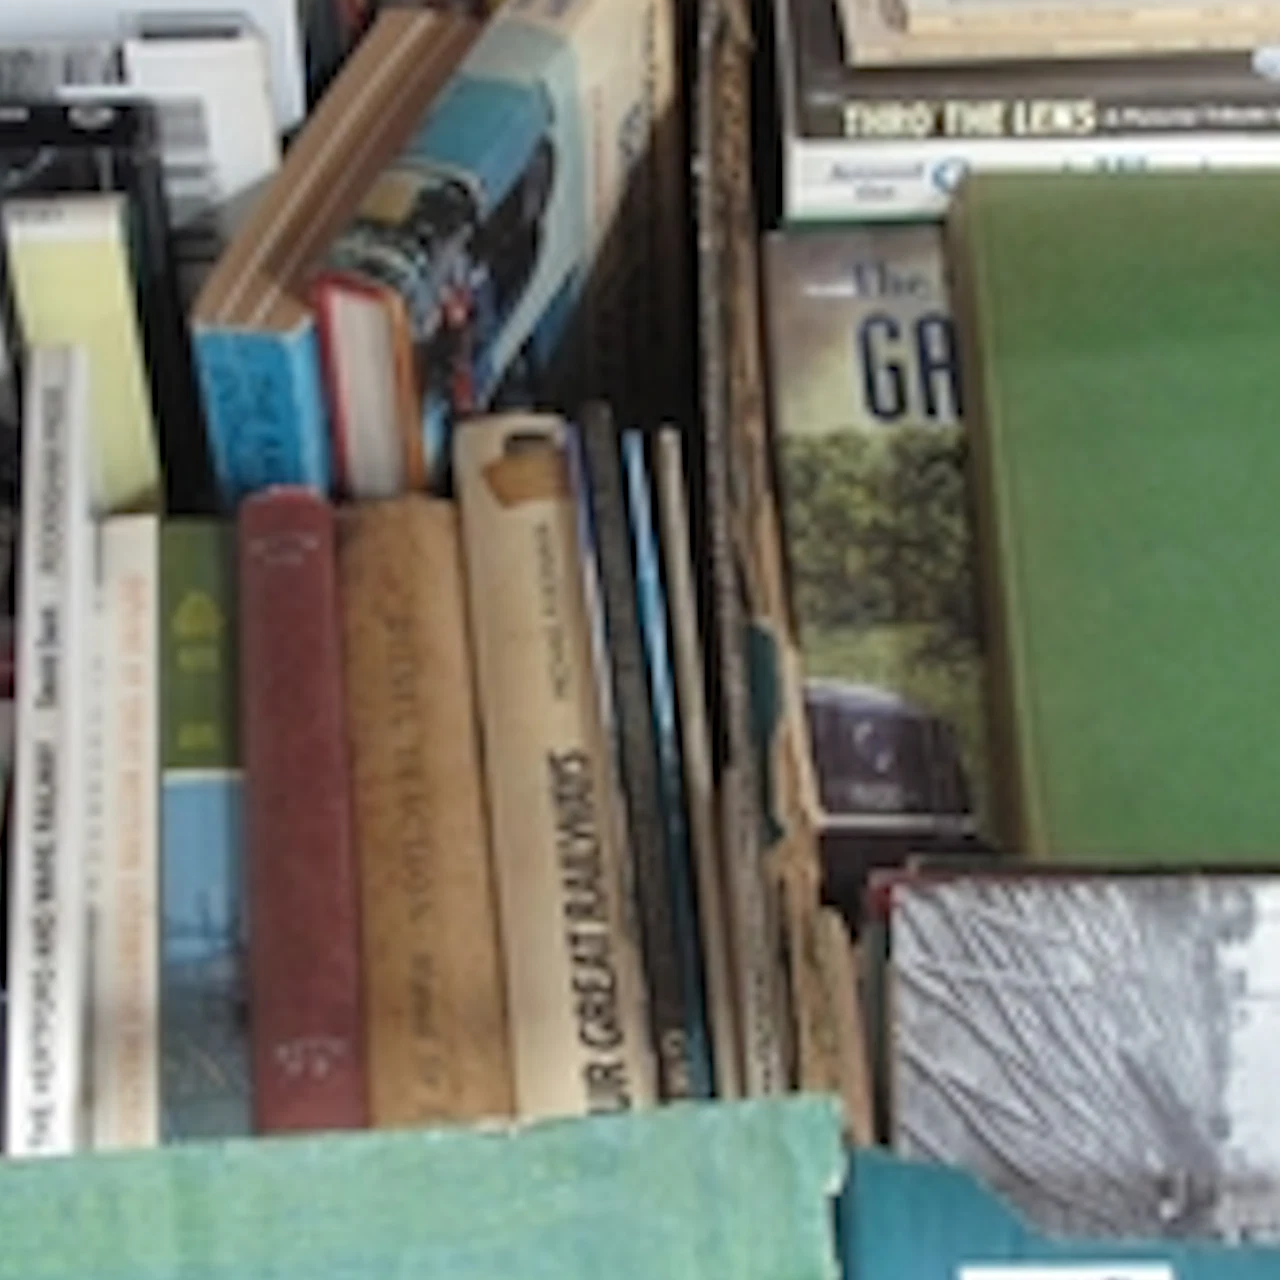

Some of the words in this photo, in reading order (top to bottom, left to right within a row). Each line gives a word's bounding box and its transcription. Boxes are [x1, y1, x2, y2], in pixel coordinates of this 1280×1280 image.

[943, 99, 1005, 137] THE
[1012, 98, 1097, 134] LENS
[31, 740, 60, 834] RAILWAY
[546, 746, 608, 924] RAILWAYS
[563, 930, 624, 1052] GREAT
[26, 1097, 56, 1148] THE
